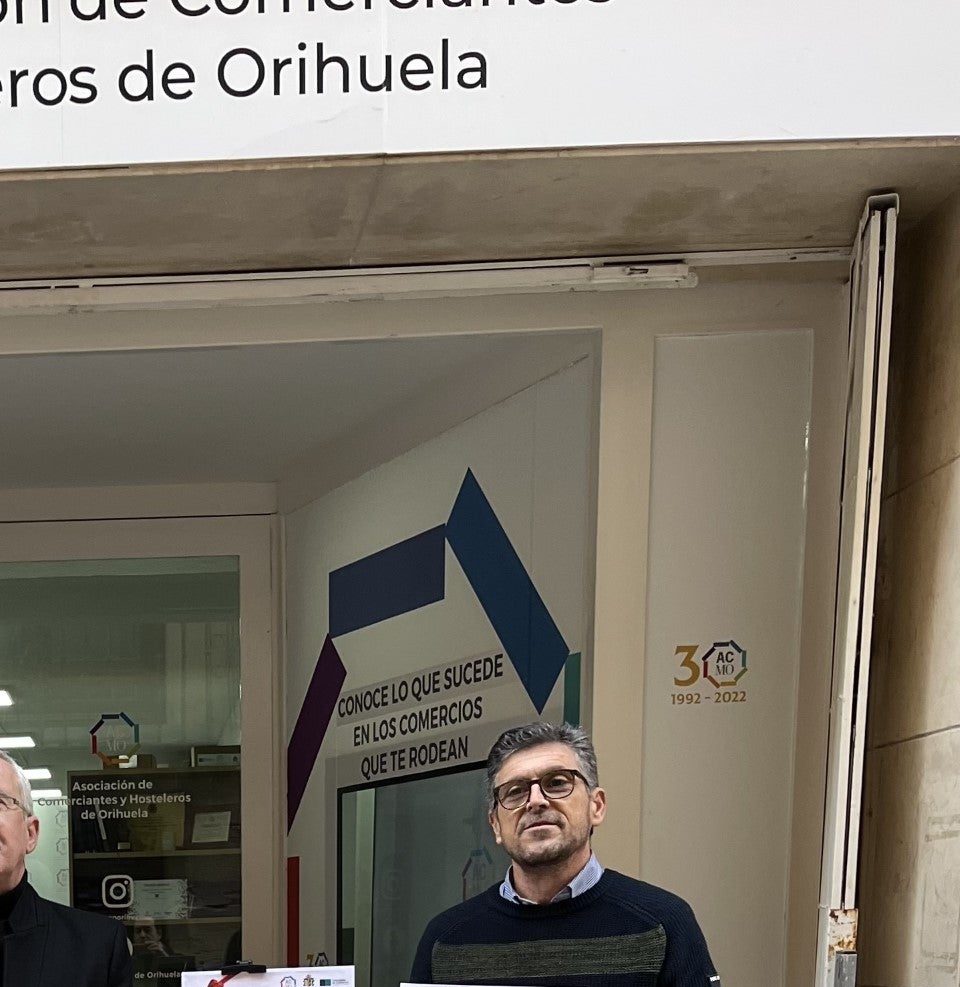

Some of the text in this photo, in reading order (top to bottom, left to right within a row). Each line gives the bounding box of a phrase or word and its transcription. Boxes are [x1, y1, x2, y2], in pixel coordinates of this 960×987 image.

[117, 49, 196, 101] de
[217, 38, 488, 97] Orihuela
[716, 651, 734, 663] AC
[715, 664, 734, 675] MO
[338, 653, 503, 718] CONOCE LO QUE SUCEDE
[353, 696, 483, 747] EN LOS COMERCIOS
[361, 736, 468, 780] QUE TE RODEAN
[72, 780, 153, 792] Asociación de
[37, 793, 192, 807] Comerciantes y Hosteleros
[81, 809, 149, 820] de Orihuela
[134, 971, 145, 979] de
